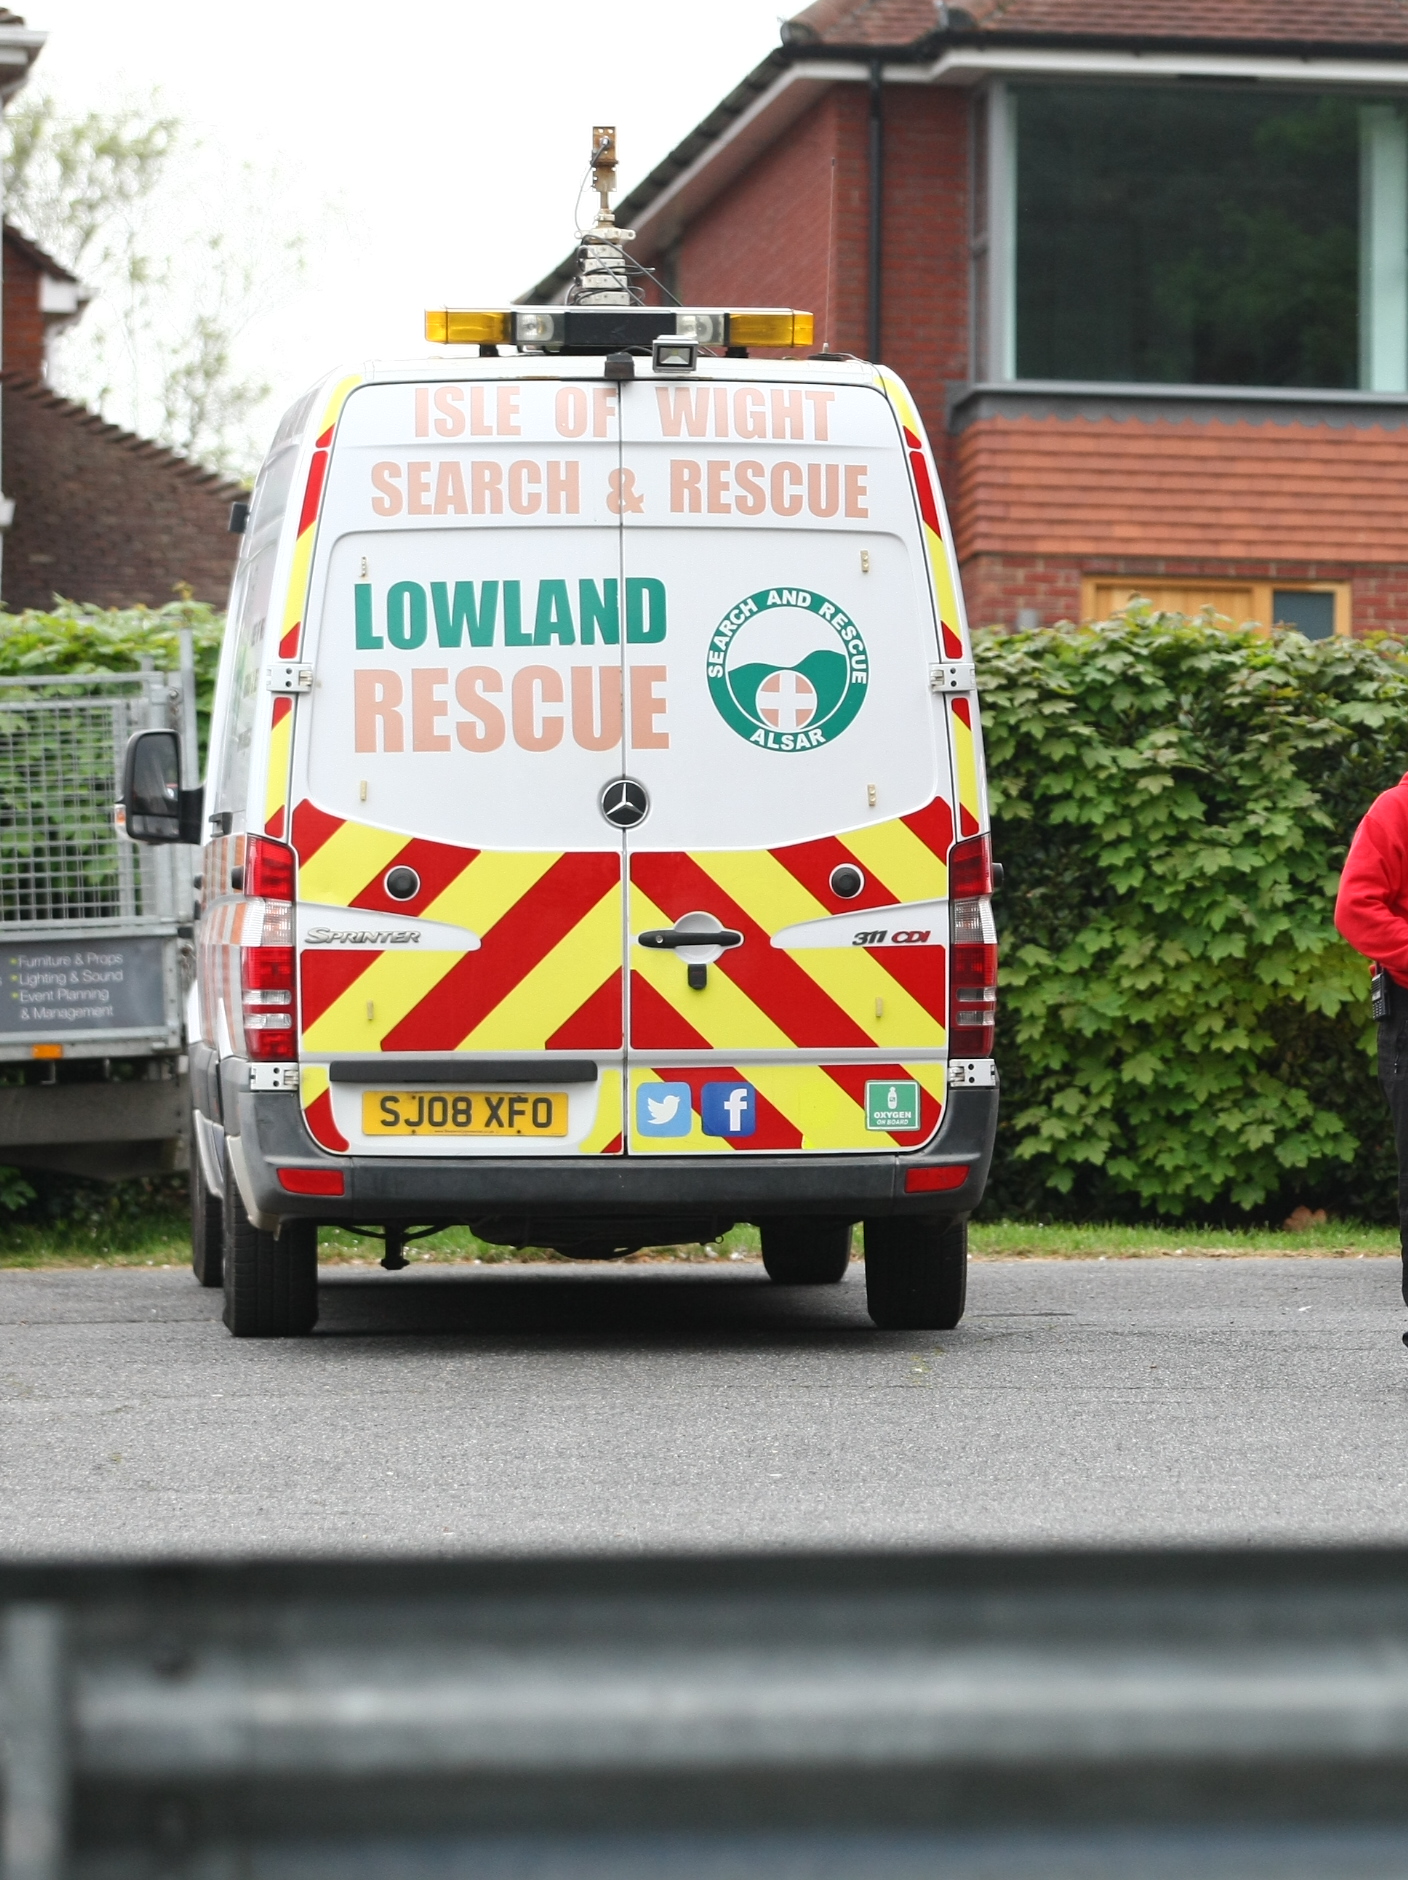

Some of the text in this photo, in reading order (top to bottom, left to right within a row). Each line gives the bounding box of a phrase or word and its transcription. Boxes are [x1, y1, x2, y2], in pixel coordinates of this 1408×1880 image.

[414, 386, 835, 442] ISLE OF WIGHT
[371, 459, 869, 519] SEARCH & RESCUE
[353, 577, 667, 650] LOWLAND
[708, 589, 867, 684] SEARCH AND RESCUE
[353, 664, 671, 753] RESCUE
[750, 728, 826, 750] ALSAR
[851, 930, 931, 946] 311 CDI
[18, 952, 124, 968] Furniture & Props
[19, 972, 67, 989] Lighting
[70, 970, 79, 983] &
[82, 969, 124, 983] Sound
[20, 987, 110, 1003] Event Planning
[20, 1004, 114, 1021] & Management
[380, 1095, 553, 1128] SJ08 XFO
[873, 1111, 912, 1119] OXYGEN
